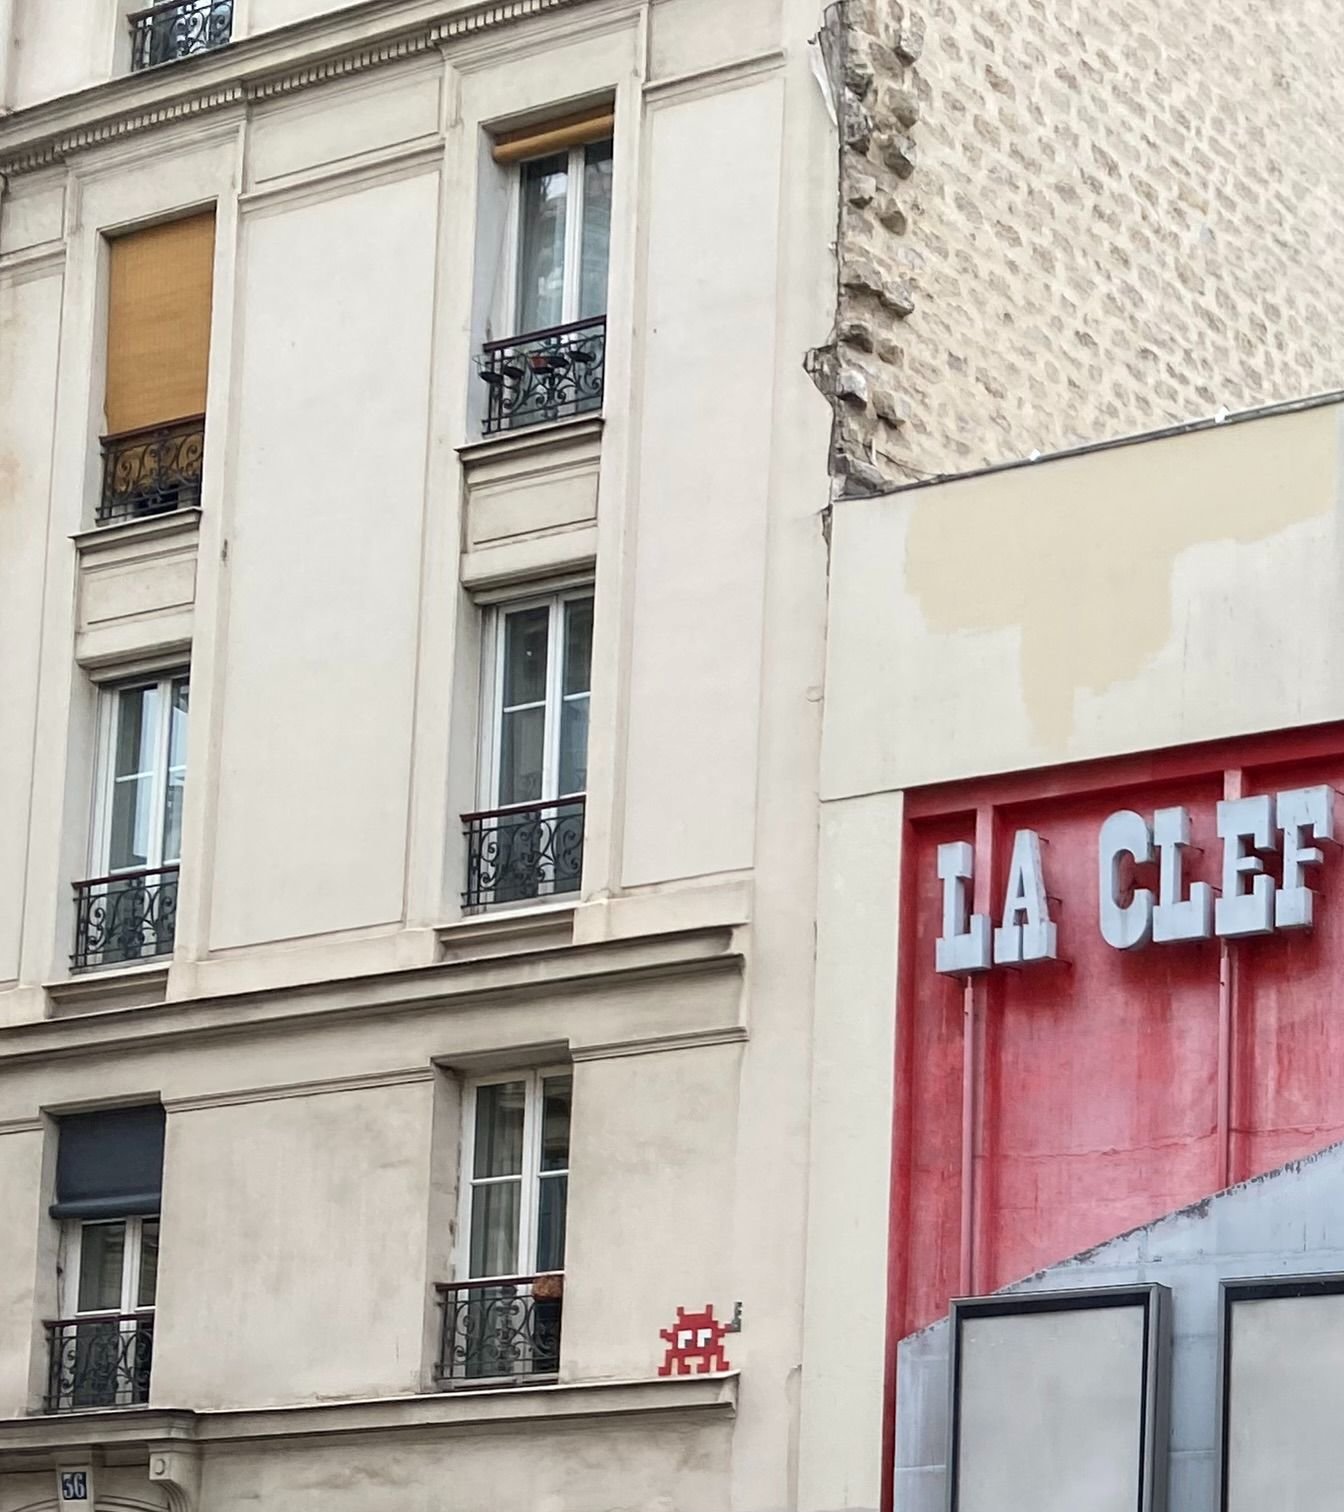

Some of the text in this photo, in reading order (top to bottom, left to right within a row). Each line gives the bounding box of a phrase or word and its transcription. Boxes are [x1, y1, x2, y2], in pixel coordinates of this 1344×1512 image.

[935, 783, 1337, 976] LA CLEF
[63, 1473, 86, 1499] 56
